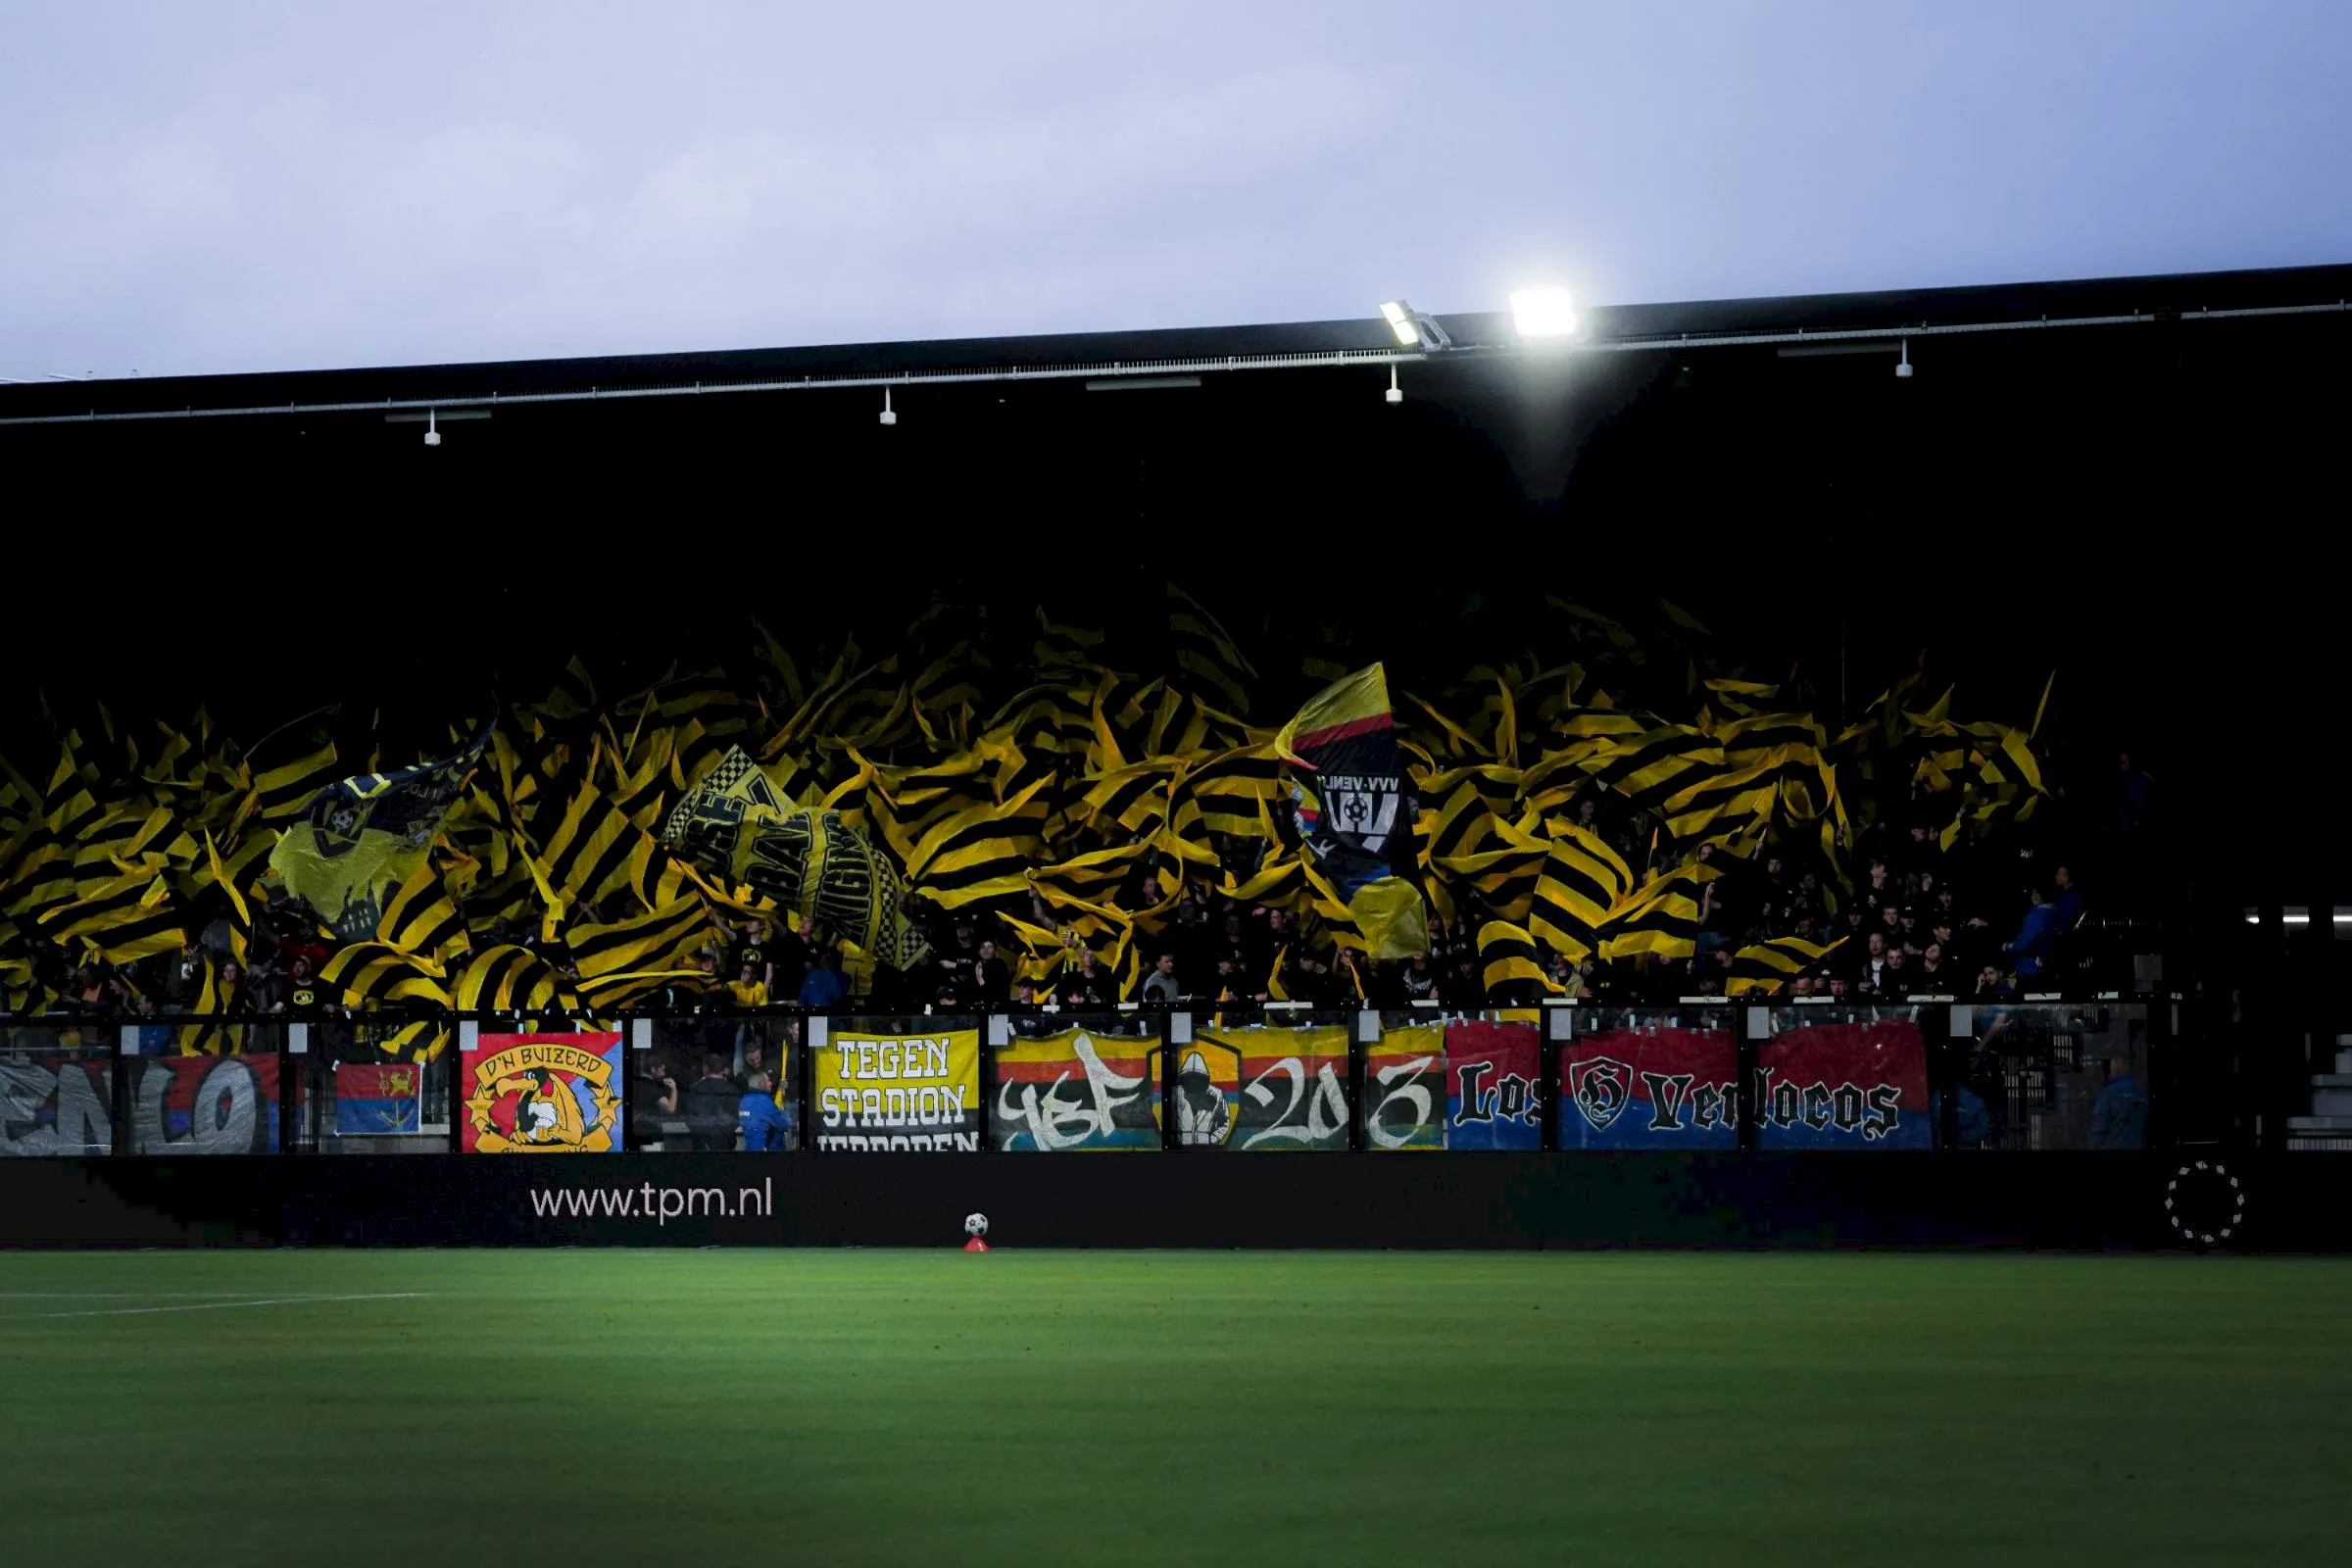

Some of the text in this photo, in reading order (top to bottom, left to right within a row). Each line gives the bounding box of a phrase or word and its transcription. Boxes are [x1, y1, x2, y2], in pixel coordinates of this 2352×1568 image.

[520, 1047, 602, 1073] BUIZERD
[836, 1037, 951, 1079] TEGEN
[821, 1084, 966, 1128] STADION
[529, 1176, 773, 1226] www.tpm.nl
